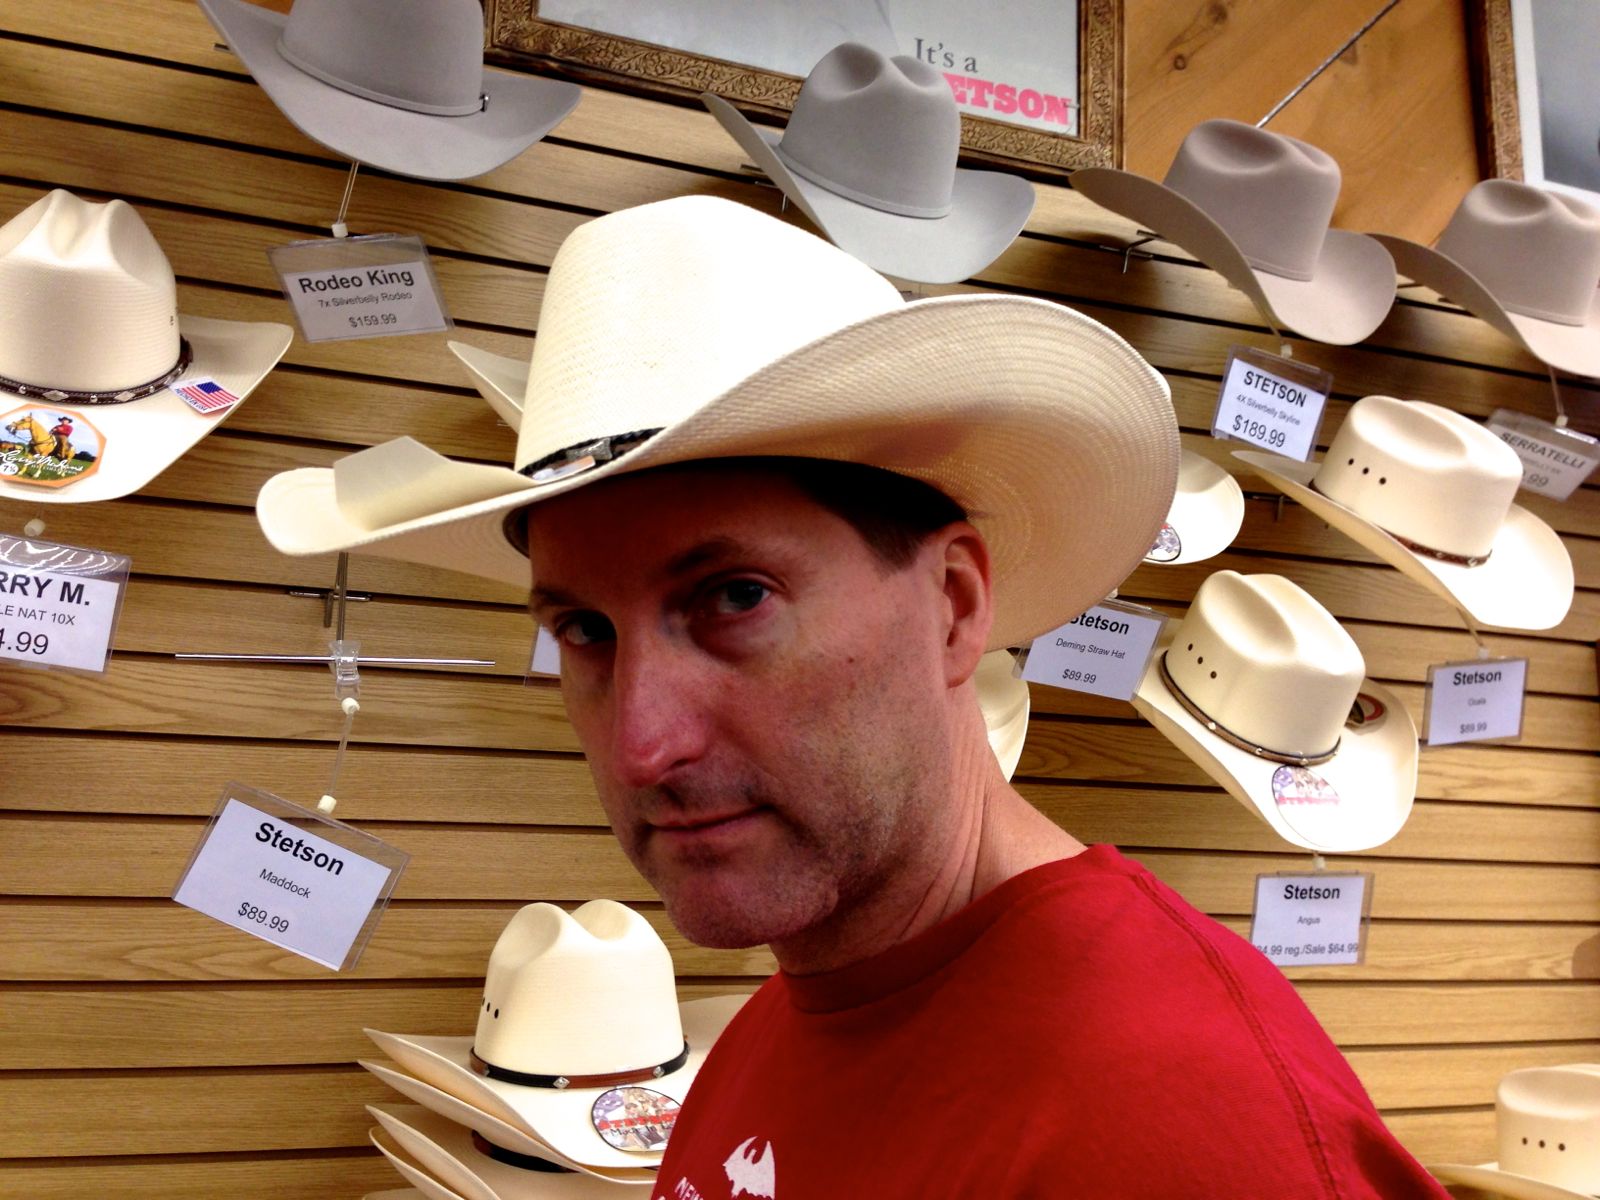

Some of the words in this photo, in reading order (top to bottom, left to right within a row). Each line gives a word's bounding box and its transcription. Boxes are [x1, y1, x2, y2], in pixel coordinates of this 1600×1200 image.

[914, 38, 955, 68] It's
[964, 56, 978, 73] a
[942, 72, 1072, 125] ETSON
[298, 275, 363, 293] Rodeo
[366, 269, 415, 287] King
[332, 294, 379, 307] Silverbelly
[381, 292, 412, 302] Rodeo
[348, 313, 397, 328] $159.99
[1244, 371, 1307, 407] STETSON
[1247, 397, 1277, 417] Silverbelly
[1232, 414, 1286, 448] $189.99
[1501, 432, 1586, 468] SERRATELLI
[1522, 470, 1549, 487] .99
[59, 581, 90, 606] M.
[0, 605, 14, 617] E
[18, 607, 47, 621] NAT
[51, 613, 76, 625] 10X
[1056, 637, 1086, 653] Deming
[1088, 644, 1110, 656] Straw
[1111, 650, 1126, 659] Hat
[1062, 669, 1097, 684] $89.99
[1453, 671, 1502, 686] Stetson
[255, 822, 344, 876] Stetson
[259, 868, 312, 899] Maddock
[1284, 884, 1341, 900] Stetson
[238, 902, 290, 933] $89.99
[1297, 916, 1321, 926] Angus
